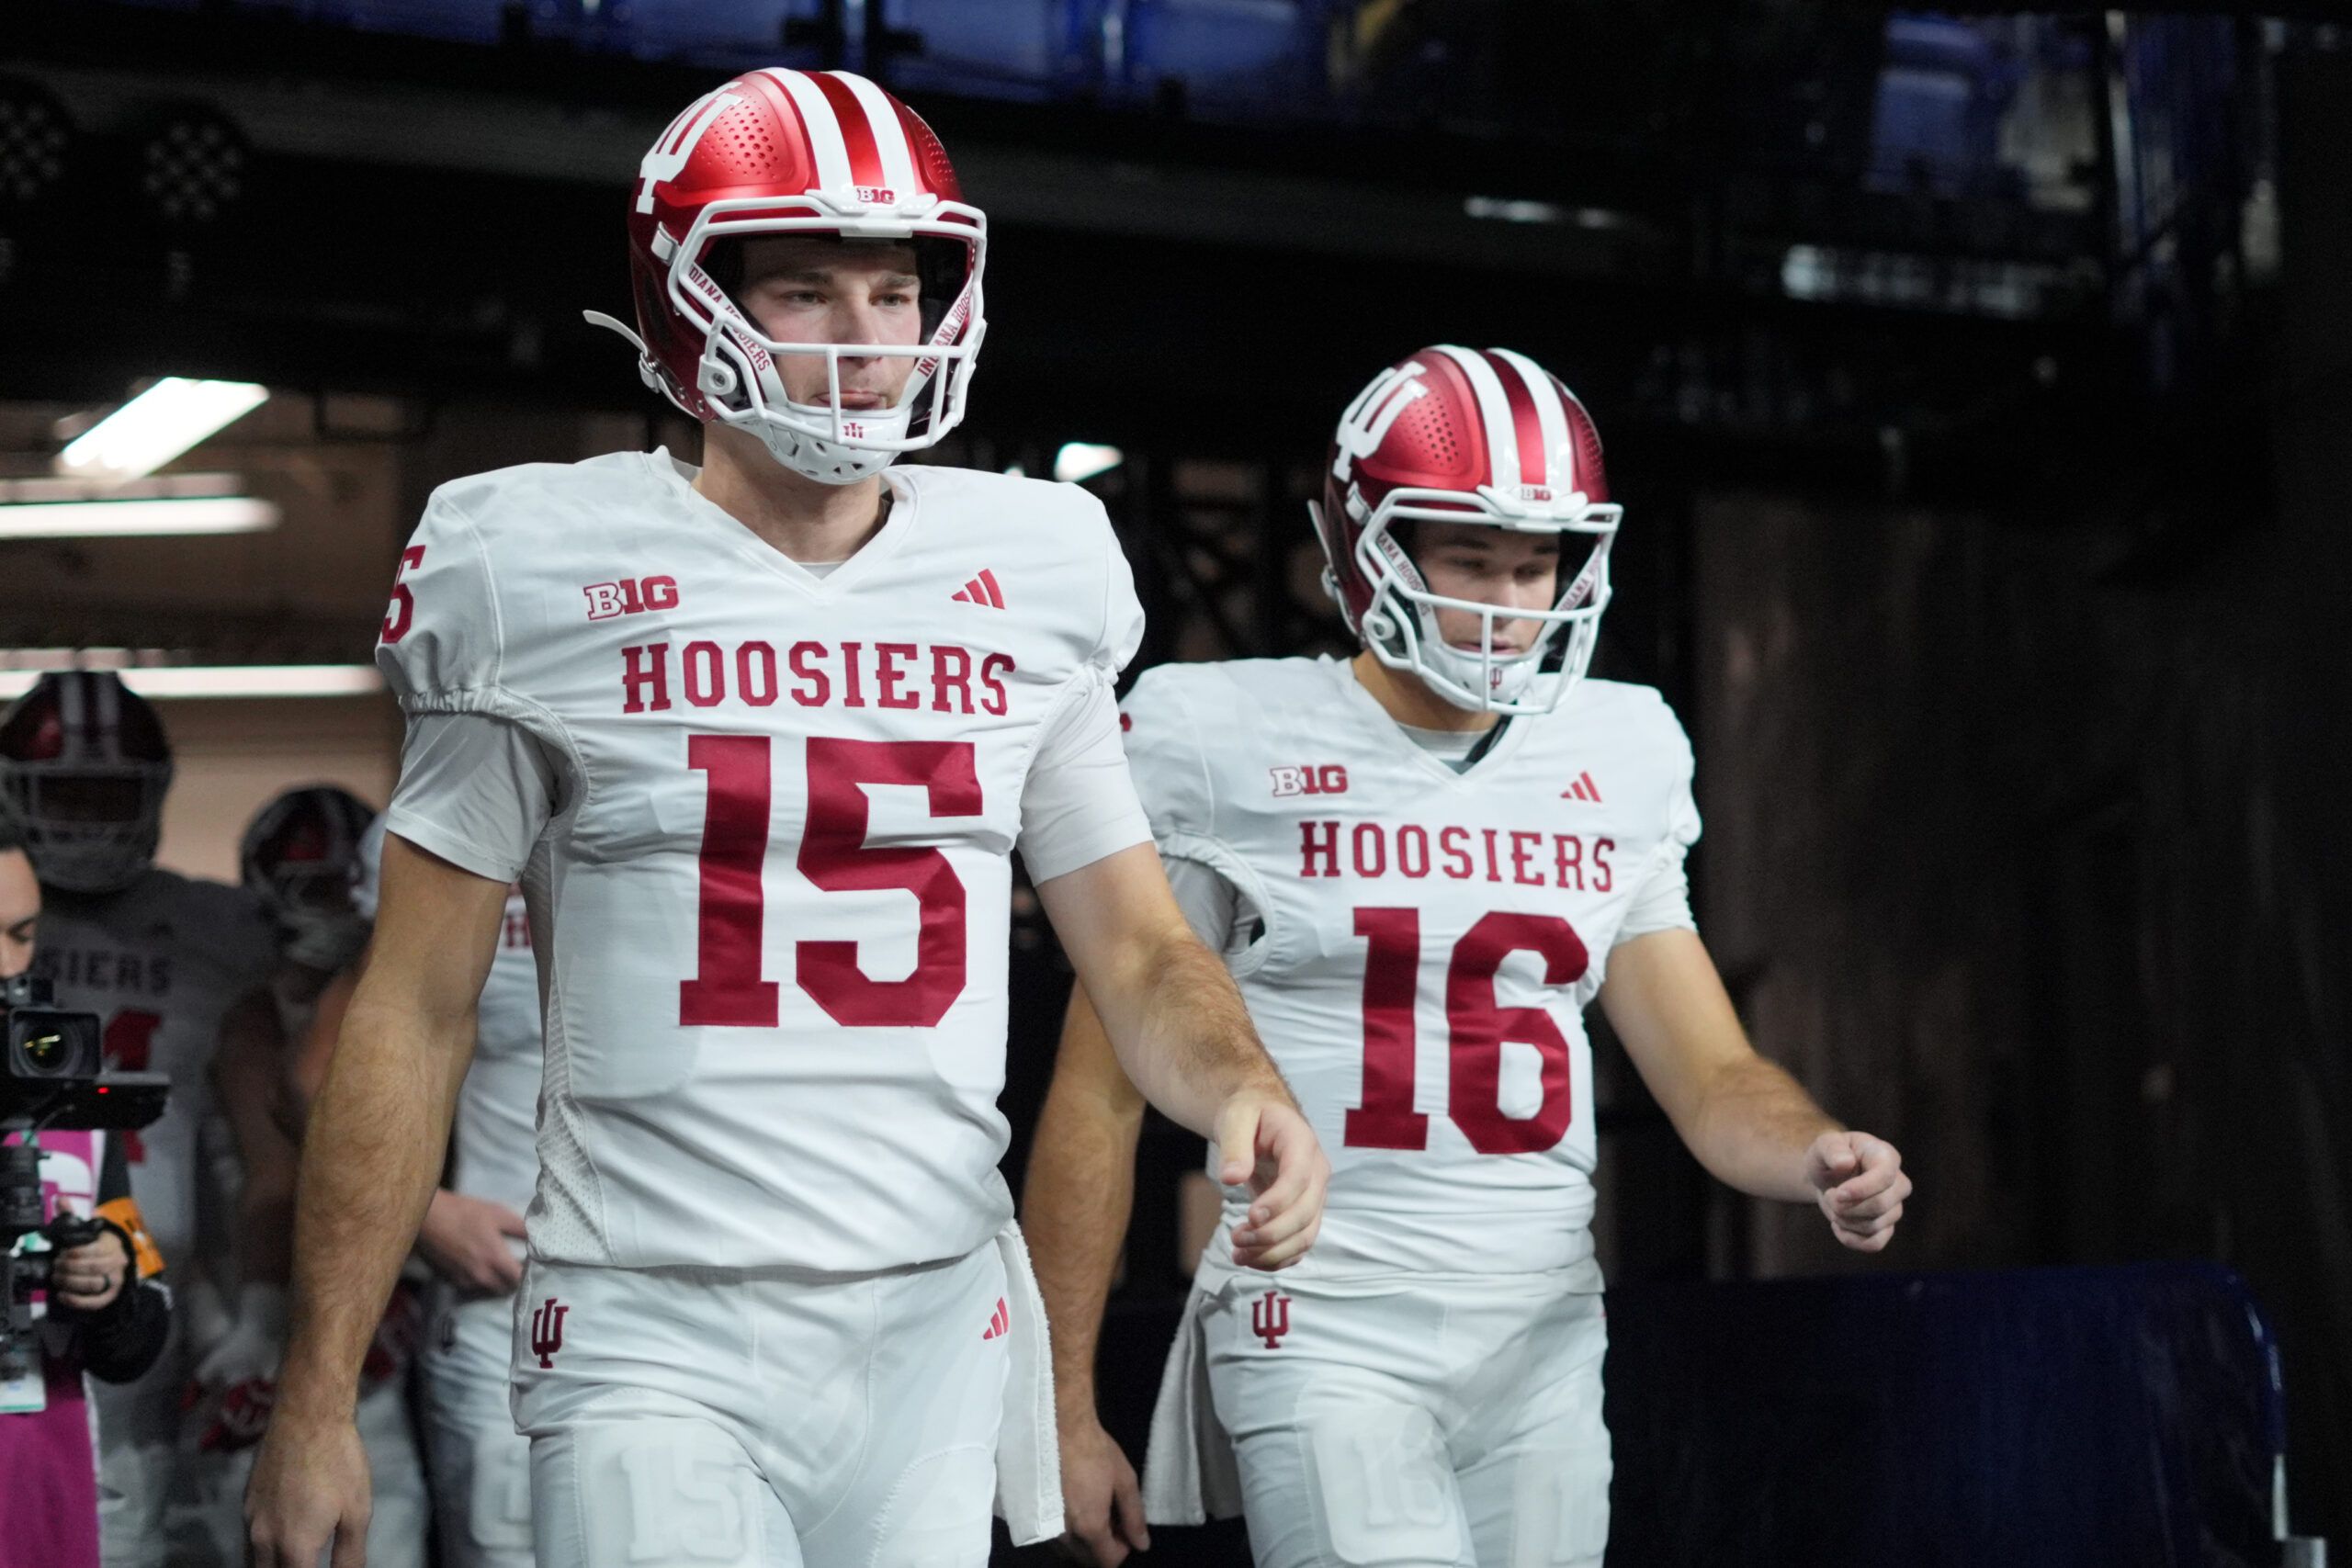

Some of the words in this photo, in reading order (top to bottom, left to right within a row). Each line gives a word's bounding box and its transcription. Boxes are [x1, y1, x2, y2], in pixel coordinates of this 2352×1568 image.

[688, 266, 723, 304] DIANA
[918, 322, 958, 378] INANA
[621, 641, 1015, 716] HOOSIERS
[680, 734, 983, 1028] 15
[1299, 821, 1615, 892] HOOSIERS
[39, 946, 175, 996] SIERS
[1343, 907, 1589, 1155] 16
